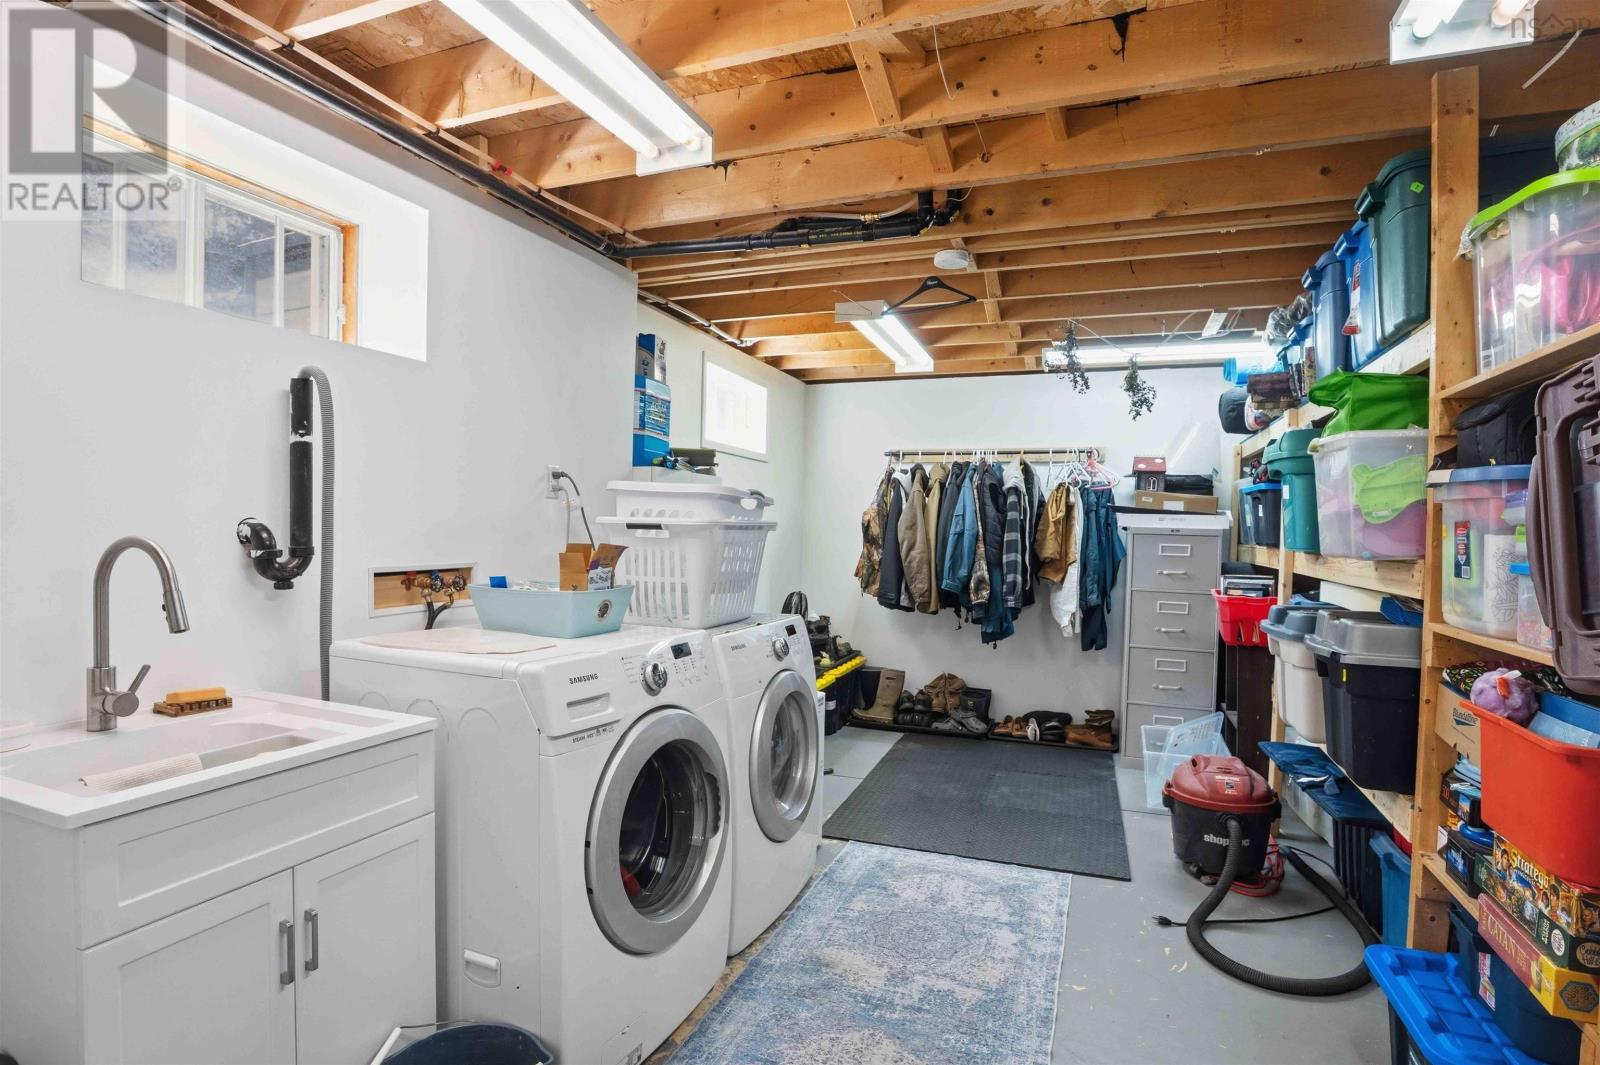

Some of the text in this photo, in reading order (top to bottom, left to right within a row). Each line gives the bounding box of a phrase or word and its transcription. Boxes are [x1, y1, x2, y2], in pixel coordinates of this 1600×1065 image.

[569, 673, 599, 684] SAMSUNG
[1509, 850, 1549, 889] Stratego
[1487, 914, 1516, 959] CATAN
